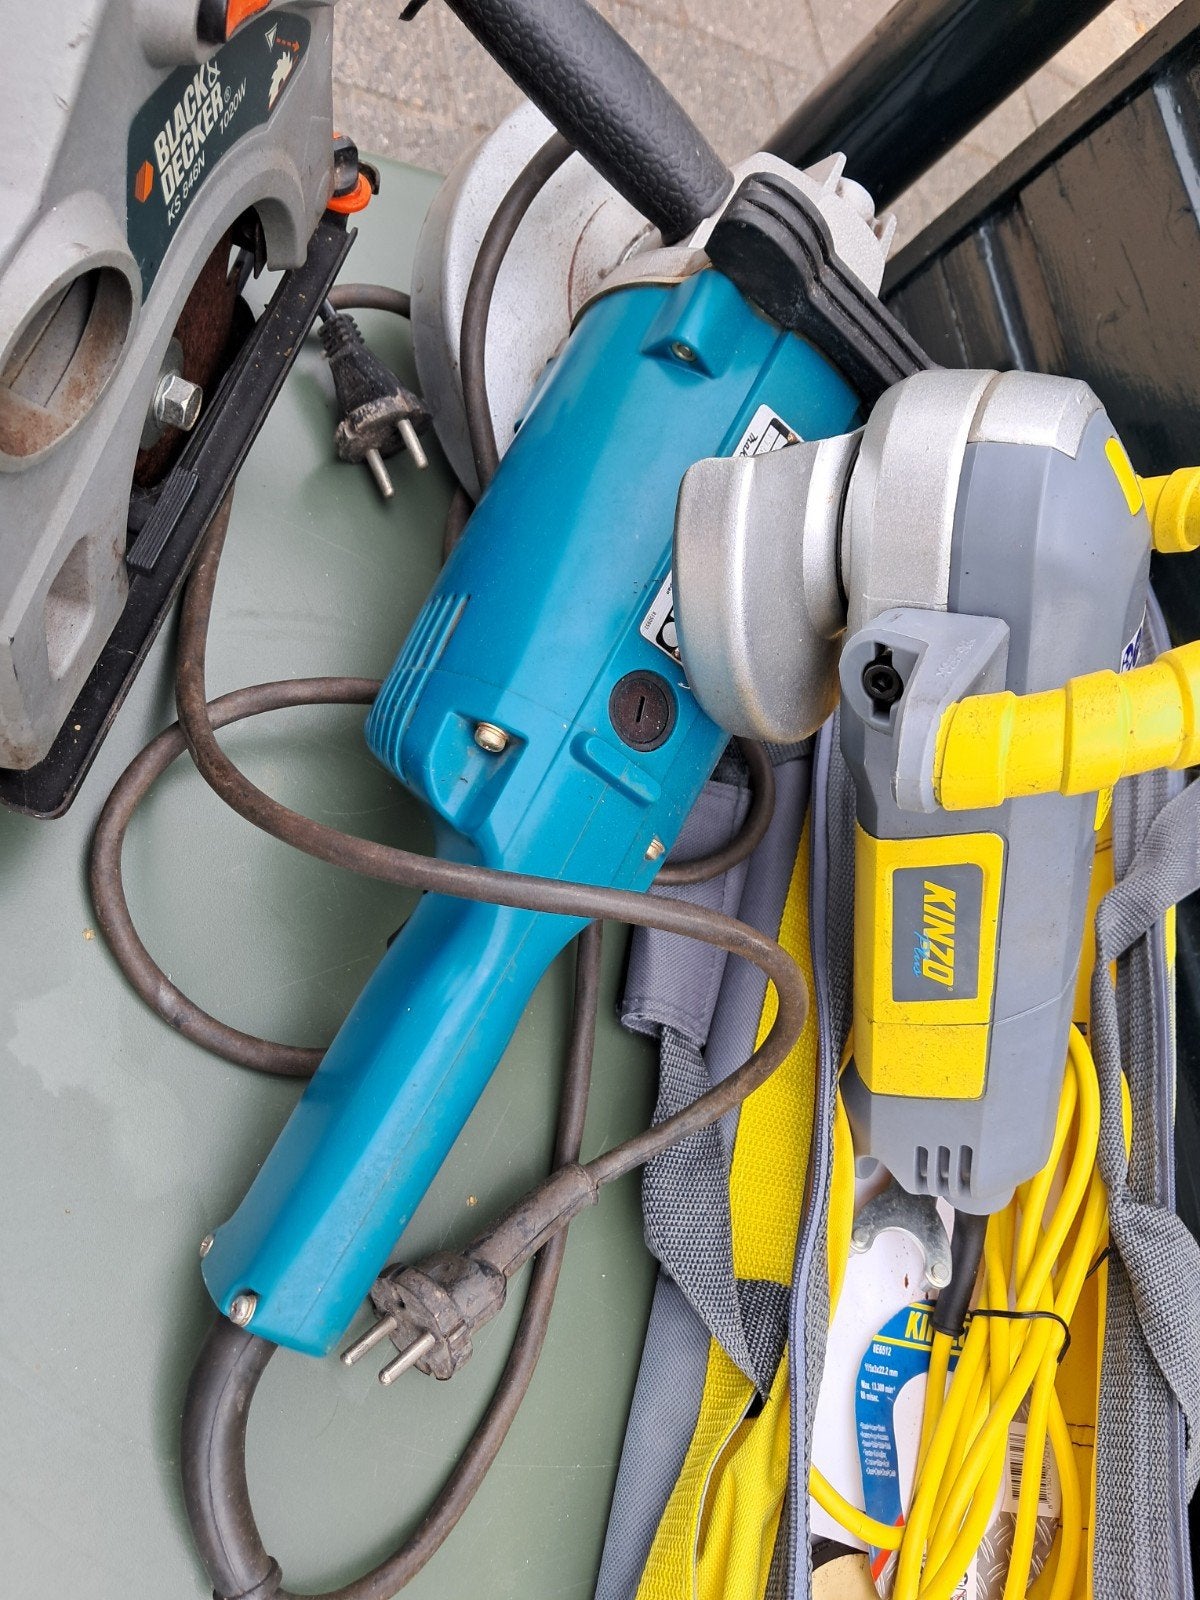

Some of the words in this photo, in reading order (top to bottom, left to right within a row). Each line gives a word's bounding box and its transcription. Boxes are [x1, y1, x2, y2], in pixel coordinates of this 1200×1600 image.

[160, 81, 224, 206] DECKER
[167, 198, 181, 226] KS
[181, 150, 205, 198] 846N
[219, 77, 247, 135] 1020W
[739, 432, 758, 457] Mak
[922, 880, 956, 986] KINZO
